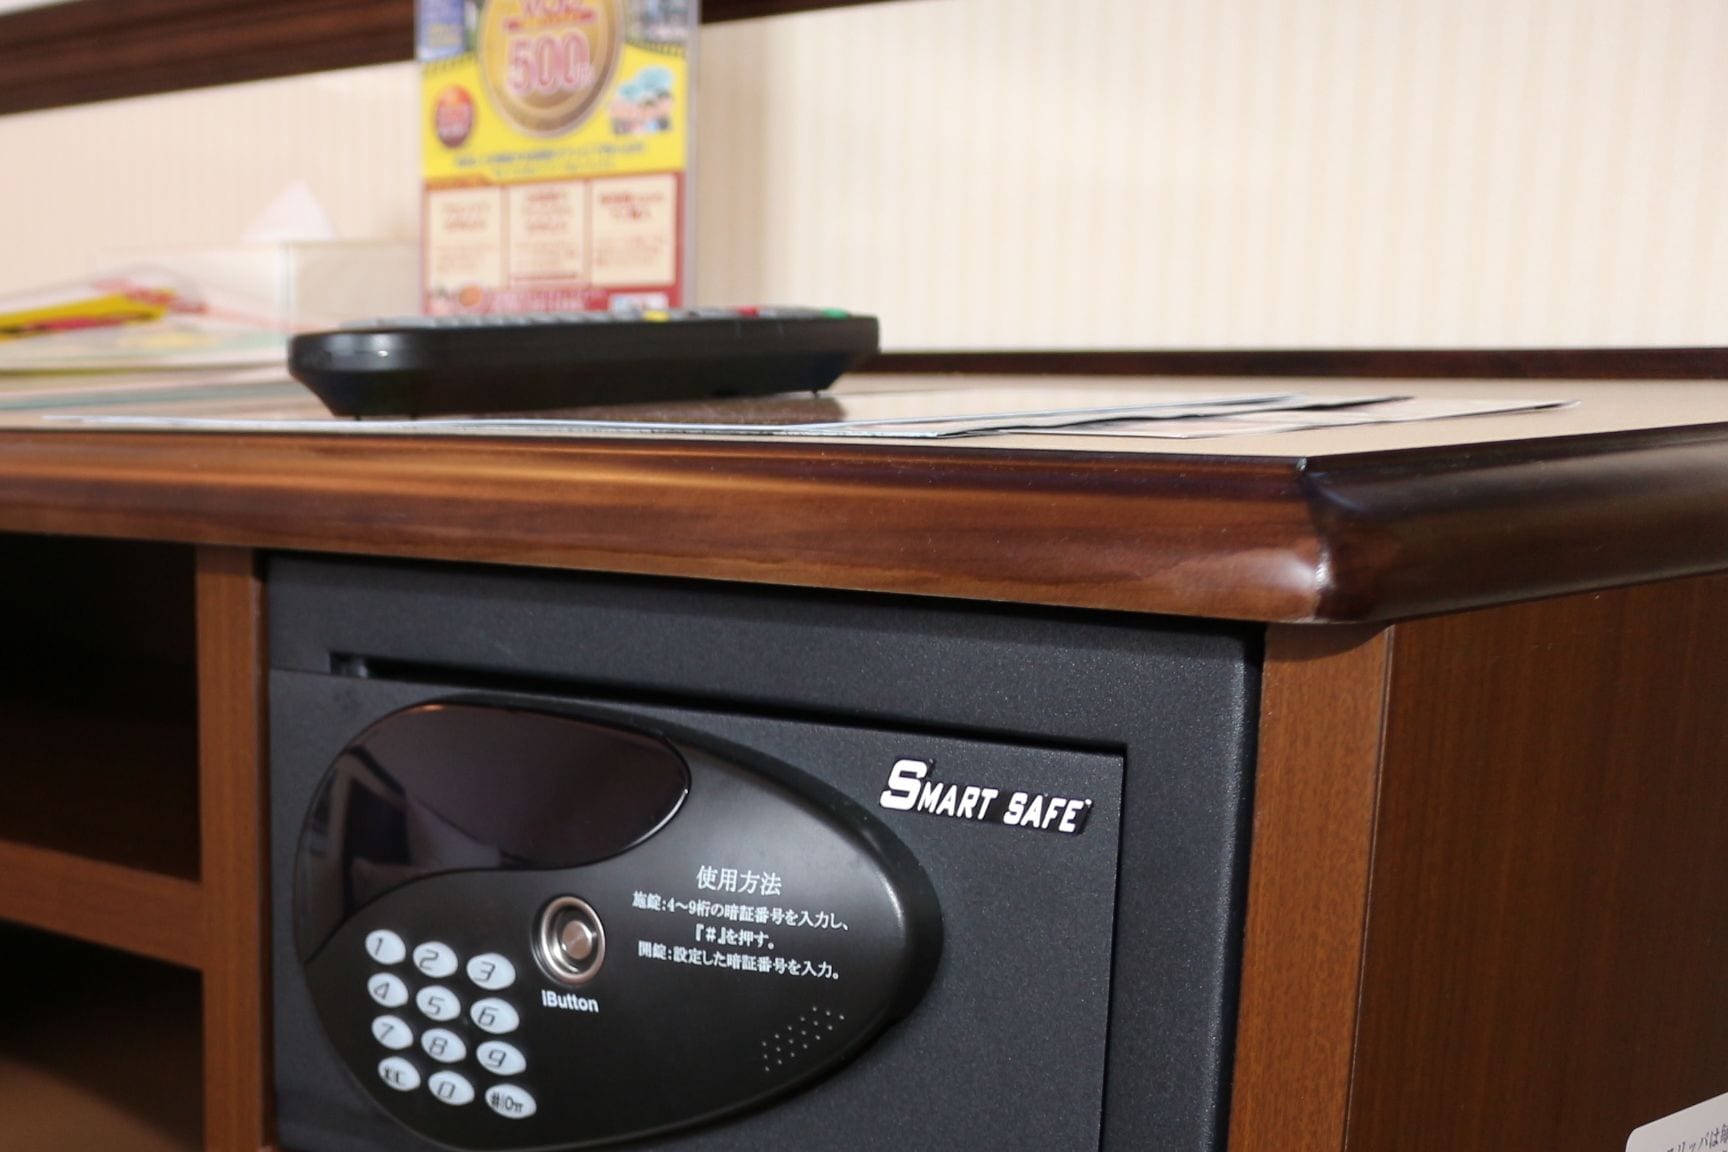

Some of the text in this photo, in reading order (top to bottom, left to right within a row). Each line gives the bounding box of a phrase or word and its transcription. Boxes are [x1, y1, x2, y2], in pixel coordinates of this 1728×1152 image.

[880, 759, 1085, 832] SMART SAFE
[696, 865, 782, 896] 使用方法
[419, 950, 439, 971] 2
[474, 961, 496, 982] 3
[373, 982, 499, 1026] 4 5 6
[381, 1023, 506, 1068] 7 8 9
[438, 1081, 456, 1099] 0
